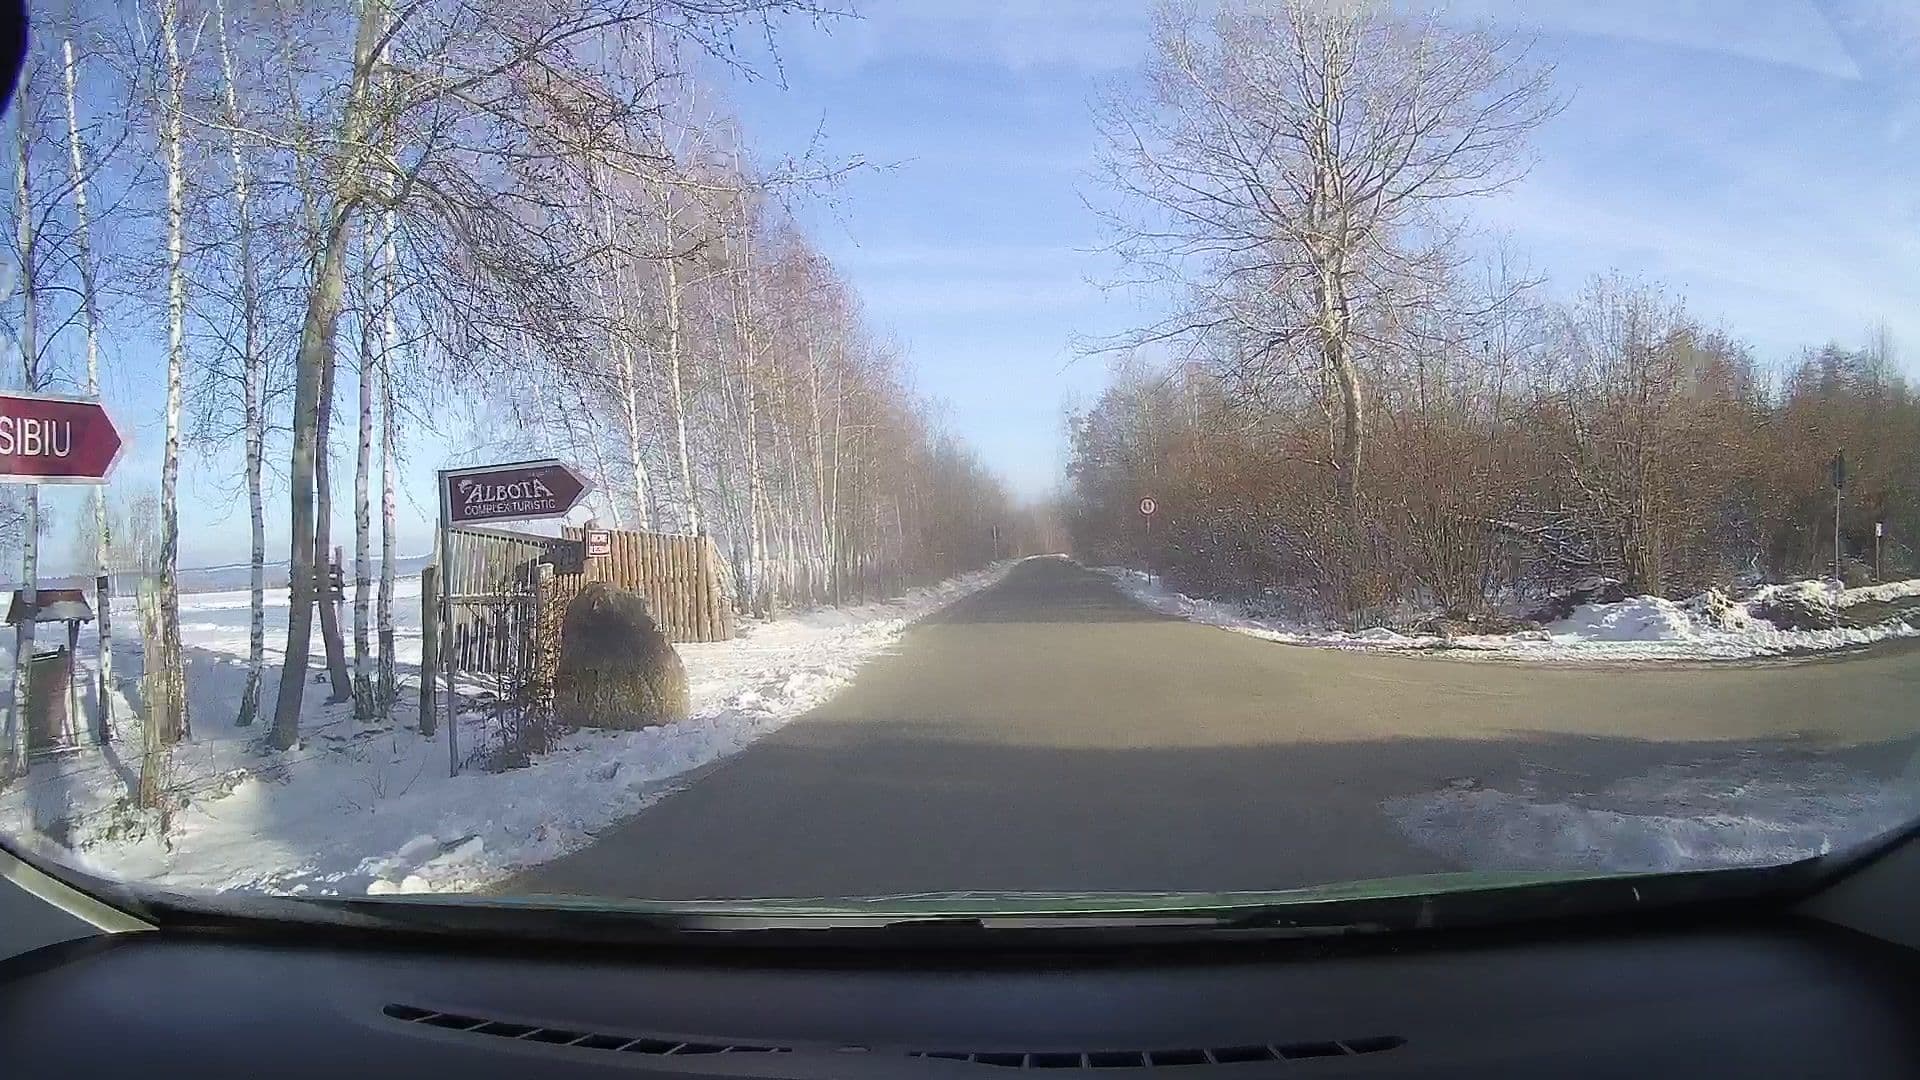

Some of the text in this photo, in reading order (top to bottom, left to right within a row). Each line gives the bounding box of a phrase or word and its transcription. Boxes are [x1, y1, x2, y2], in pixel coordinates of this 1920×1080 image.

[0, 416, 71, 457] SIBIU
[464, 478, 554, 504] ALBOTA
[464, 499, 556, 516] COMPLEX TURISTIC
